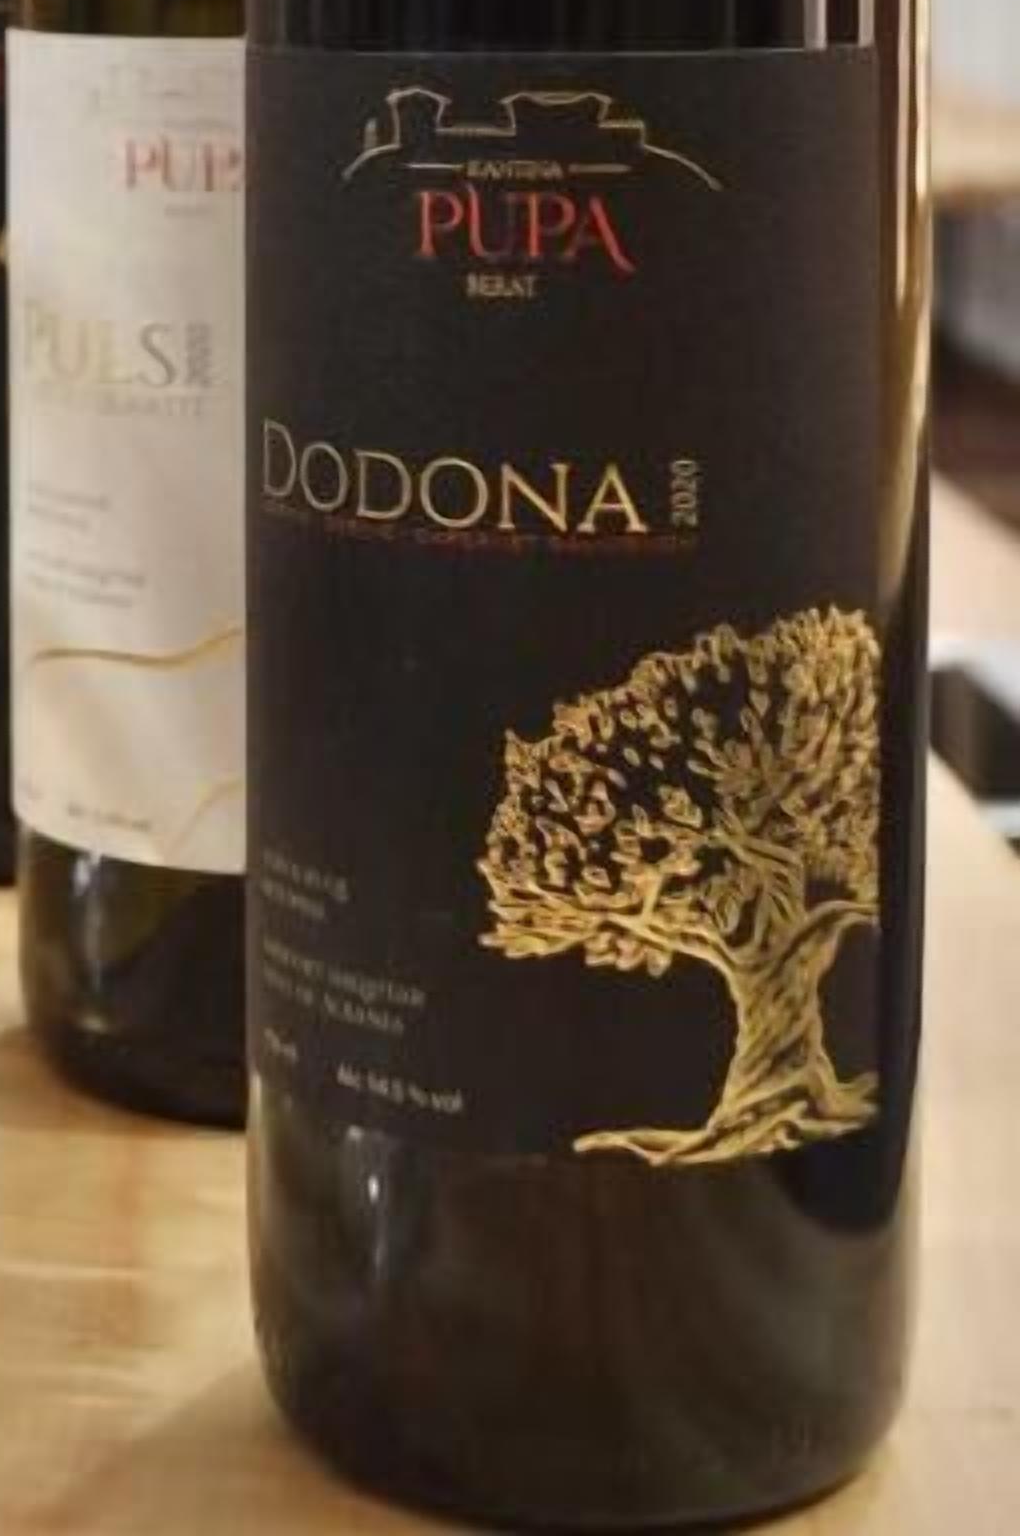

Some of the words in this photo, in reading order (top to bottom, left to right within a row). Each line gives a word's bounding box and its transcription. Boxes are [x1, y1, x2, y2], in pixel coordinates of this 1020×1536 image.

[414, 182, 637, 272] PUPA
[466, 274, 539, 298] BERAT
[263, 418, 649, 533] DODONA
[671, 460, 699, 526] 2020
